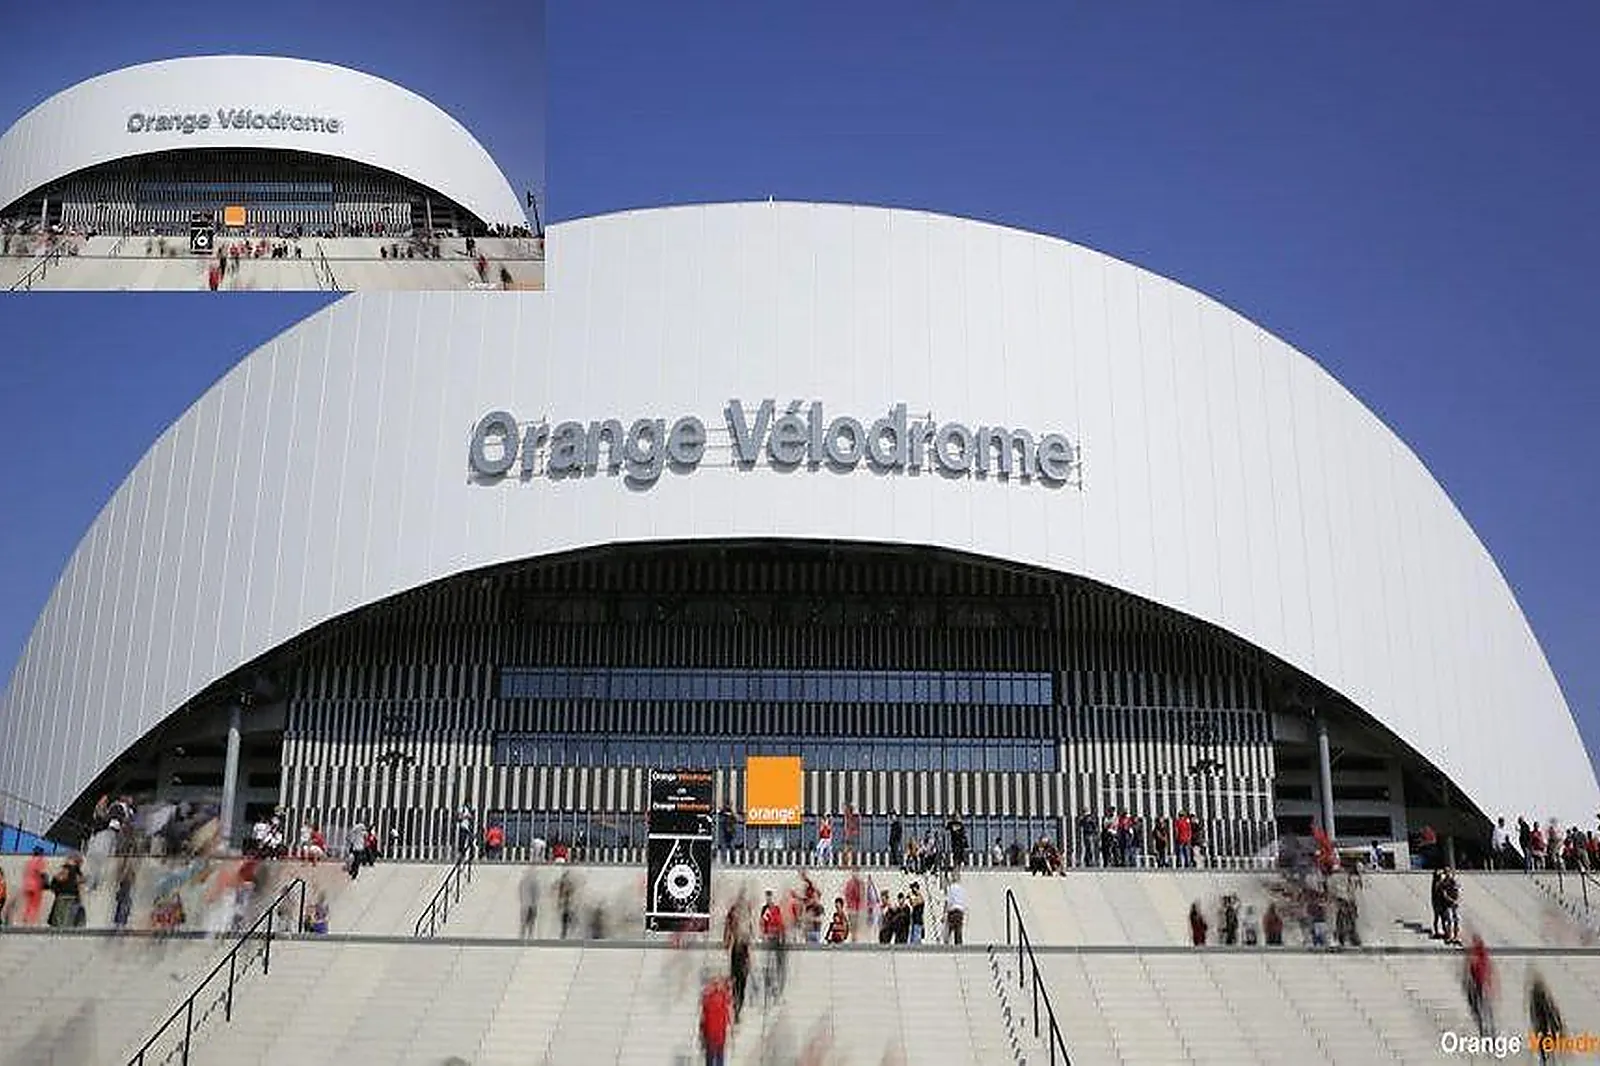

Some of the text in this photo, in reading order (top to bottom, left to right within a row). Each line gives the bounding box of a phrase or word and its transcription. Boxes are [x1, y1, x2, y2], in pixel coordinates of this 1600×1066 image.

[127, 108, 340, 134] Orange Vélodrome
[469, 399, 1076, 490] Orange Vélodrome
[749, 807, 795, 822] orange
